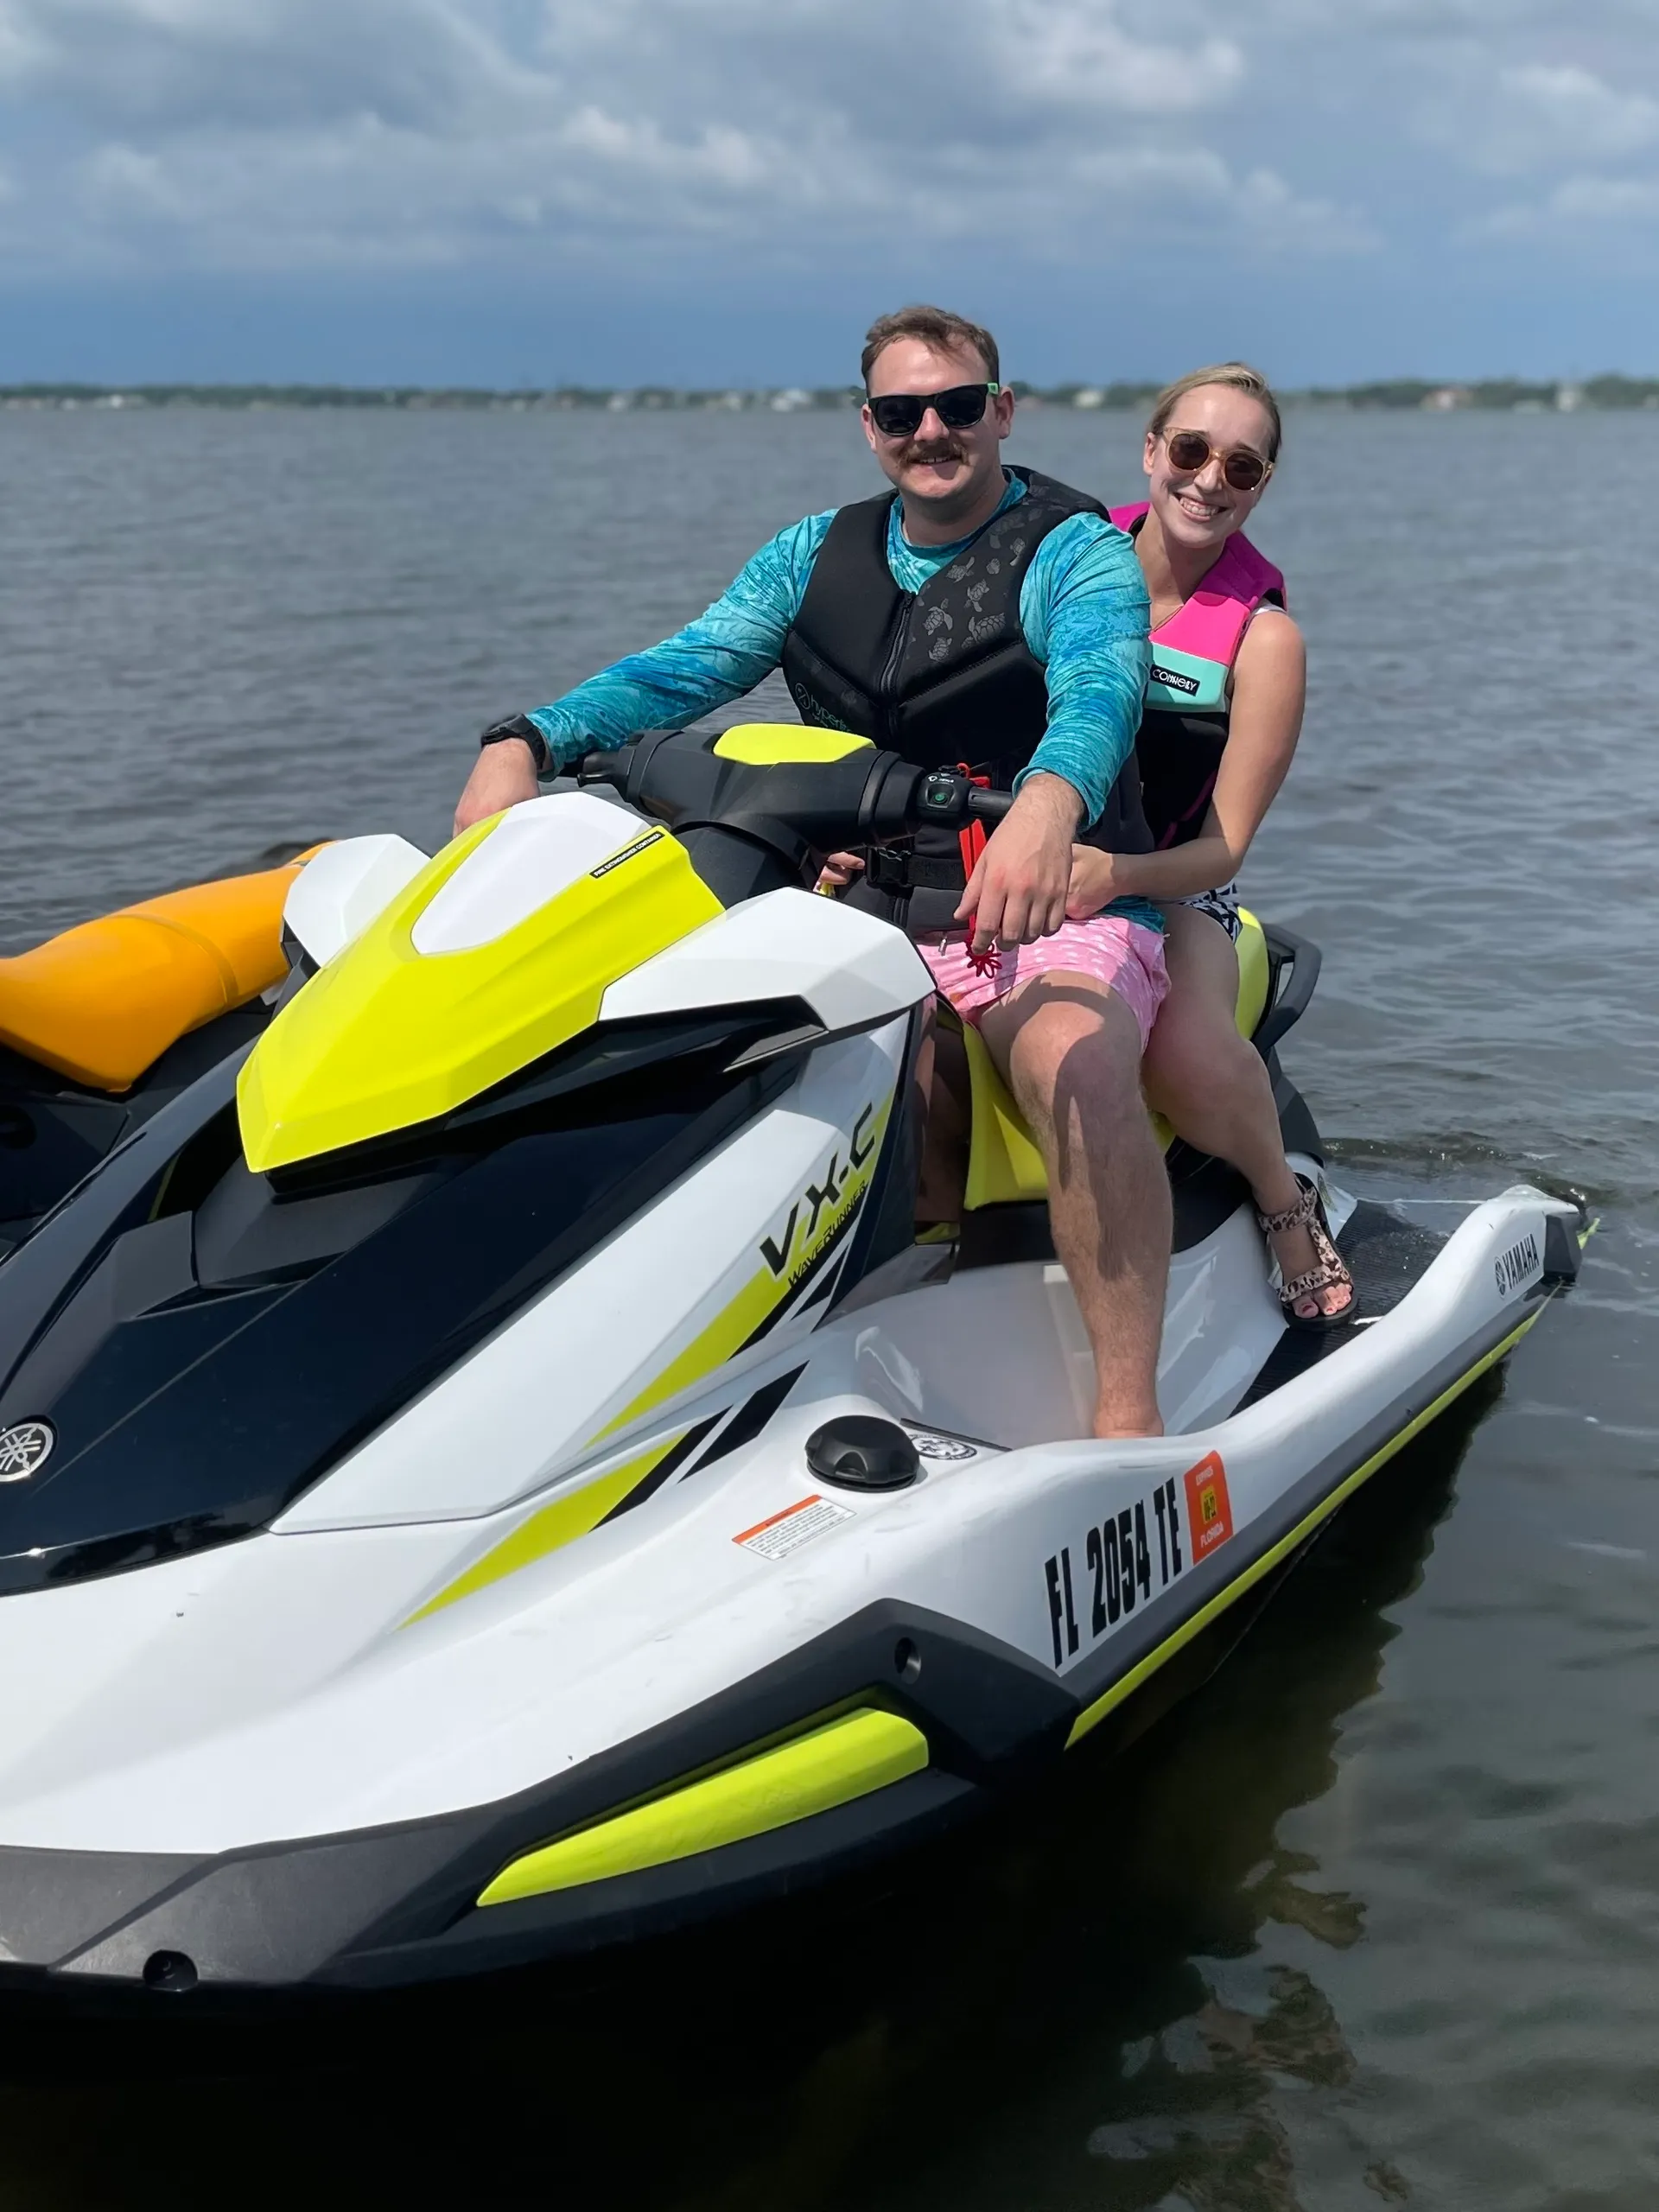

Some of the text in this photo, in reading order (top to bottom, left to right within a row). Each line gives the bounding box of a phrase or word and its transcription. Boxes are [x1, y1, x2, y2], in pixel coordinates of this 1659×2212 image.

[760, 1102, 874, 1276] VX-C
[1502, 1234, 1540, 1289] YAMAHA
[1045, 1477, 1182, 1669] FL 2054 TE
